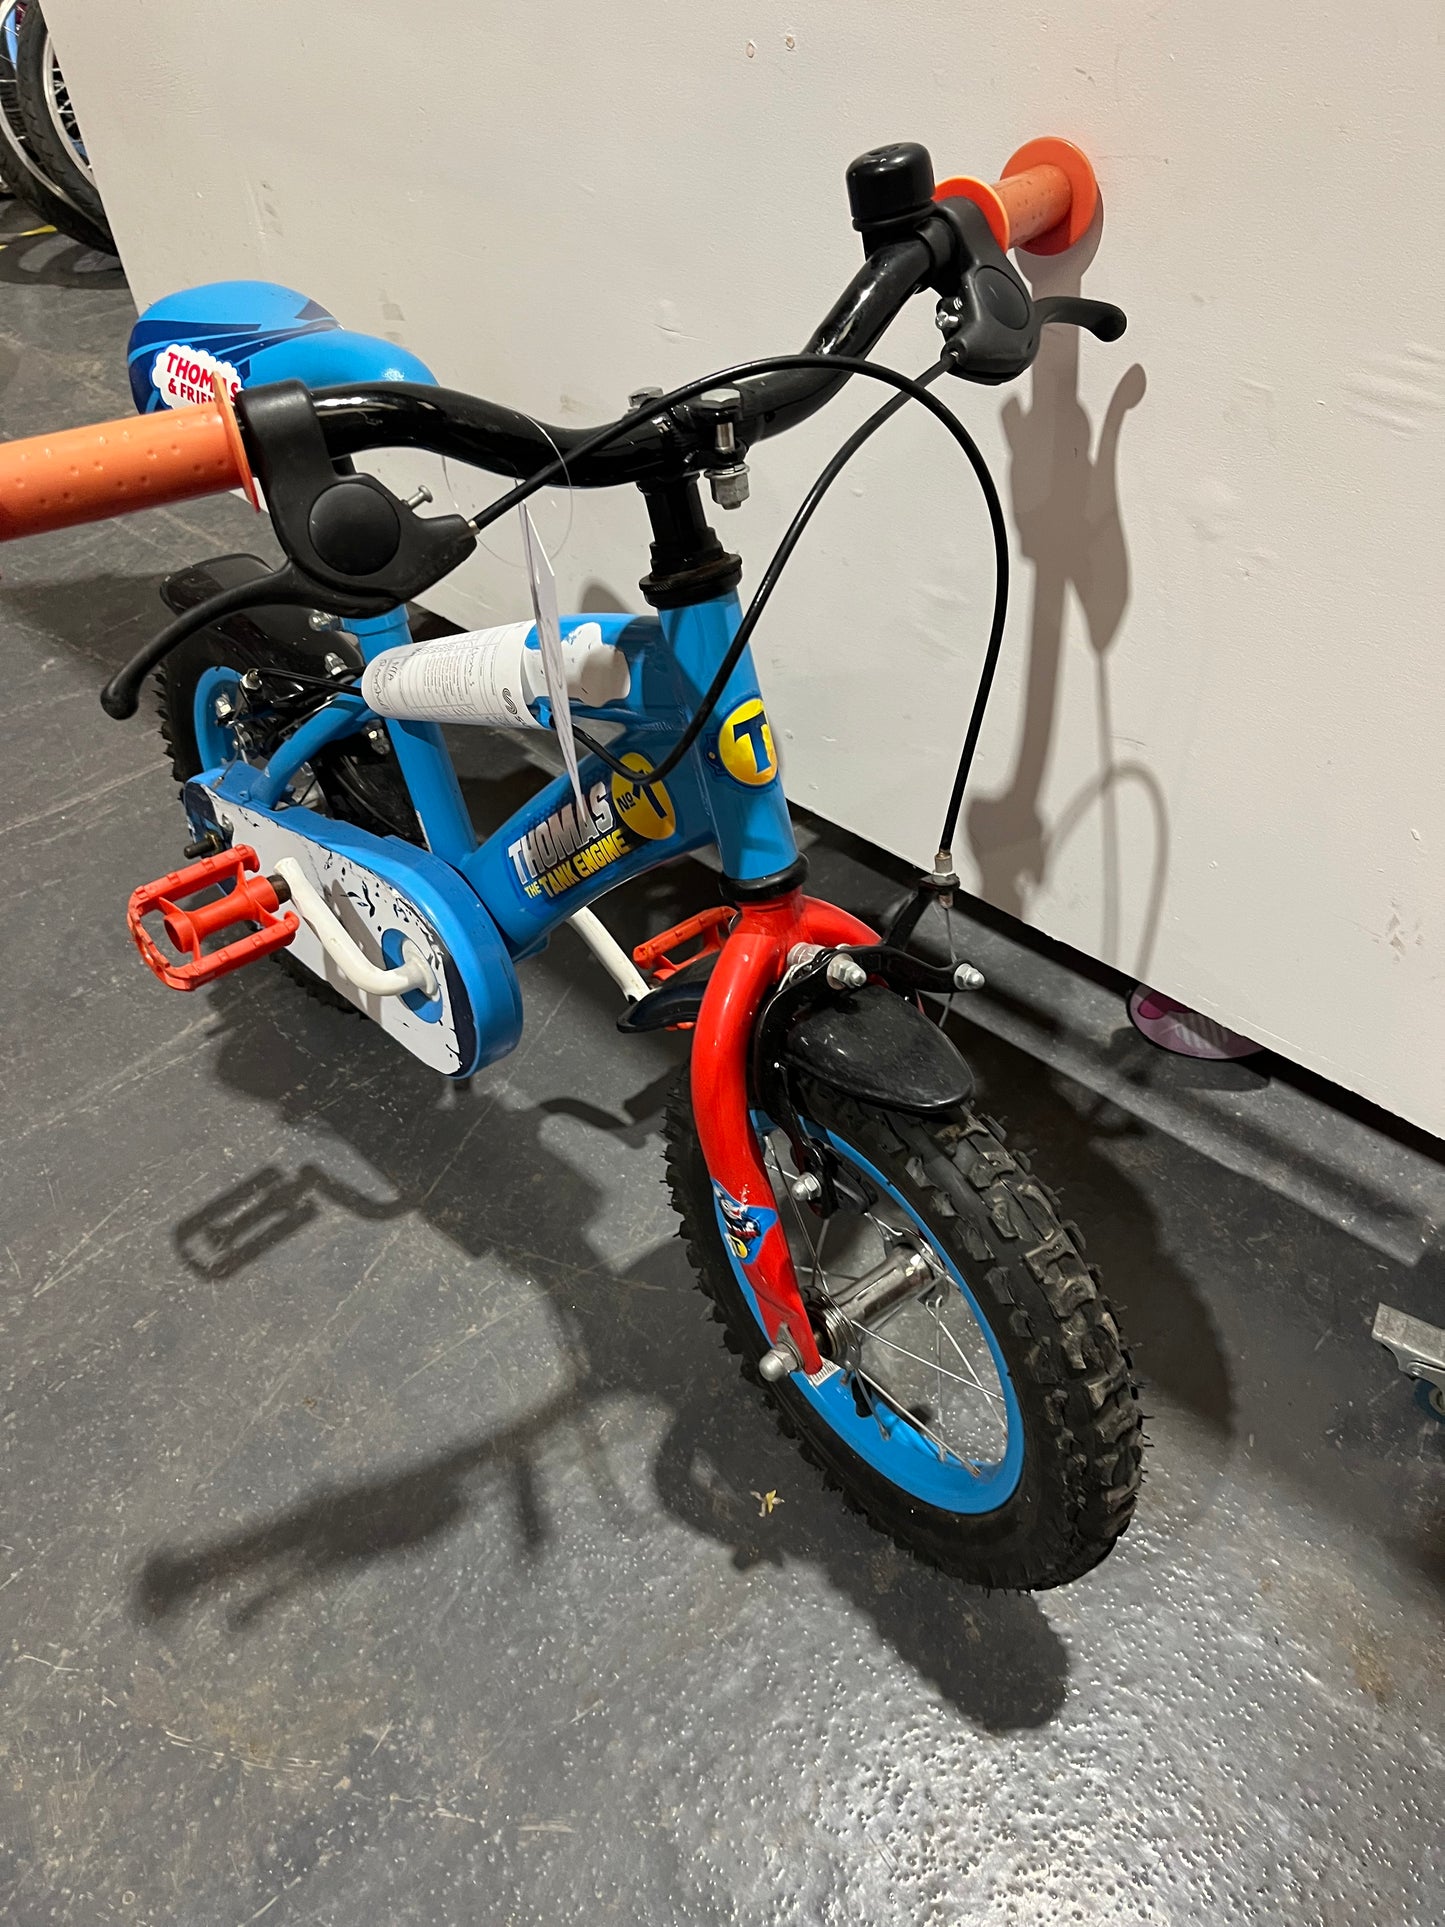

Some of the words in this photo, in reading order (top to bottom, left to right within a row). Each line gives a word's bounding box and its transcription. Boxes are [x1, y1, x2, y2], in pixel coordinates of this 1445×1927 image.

[168, 378, 177, 395] &
[507, 781, 614, 885] THOMAS
[524, 881, 542, 899] THE
[539, 863, 581, 898] TANK
[574, 828, 632, 878] ENGINE
